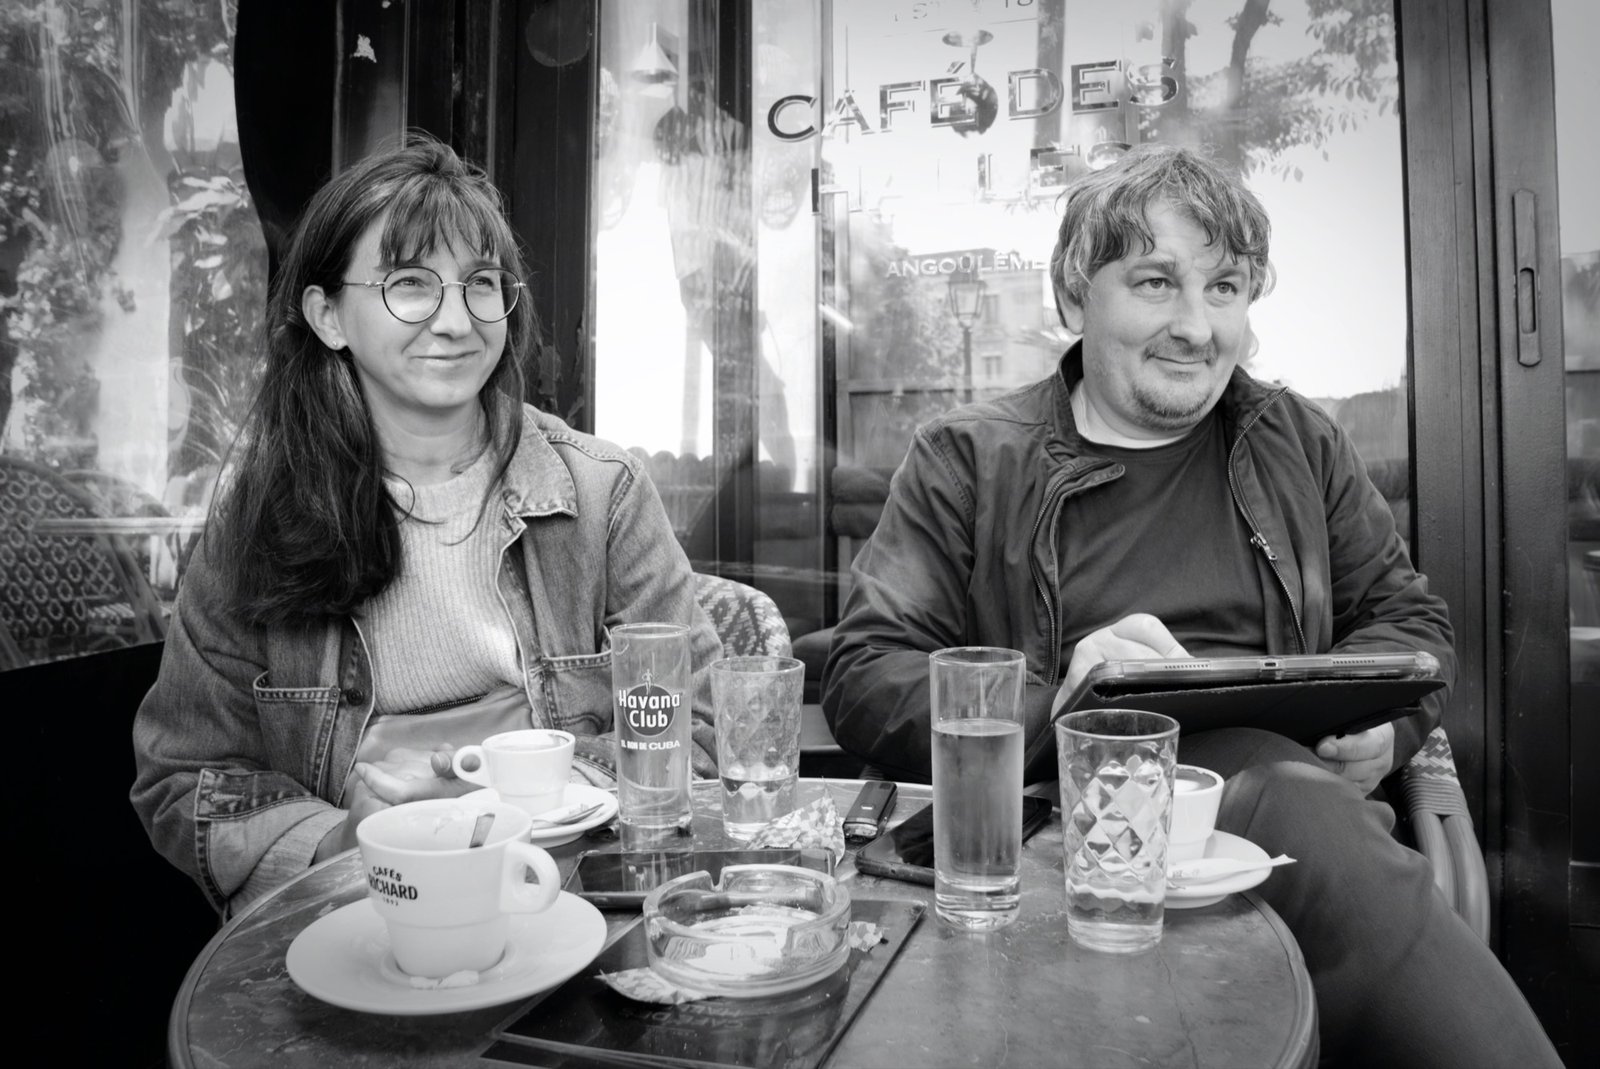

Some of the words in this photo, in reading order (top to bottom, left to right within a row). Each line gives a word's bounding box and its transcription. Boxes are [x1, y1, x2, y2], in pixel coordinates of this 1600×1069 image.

[767, 61, 980, 142] CAFÉ
[1007, 57, 1179, 121] DES
[618, 689, 680, 709] Havana
[629, 710, 669, 728] Club
[648, 739, 681, 751] CUBA
